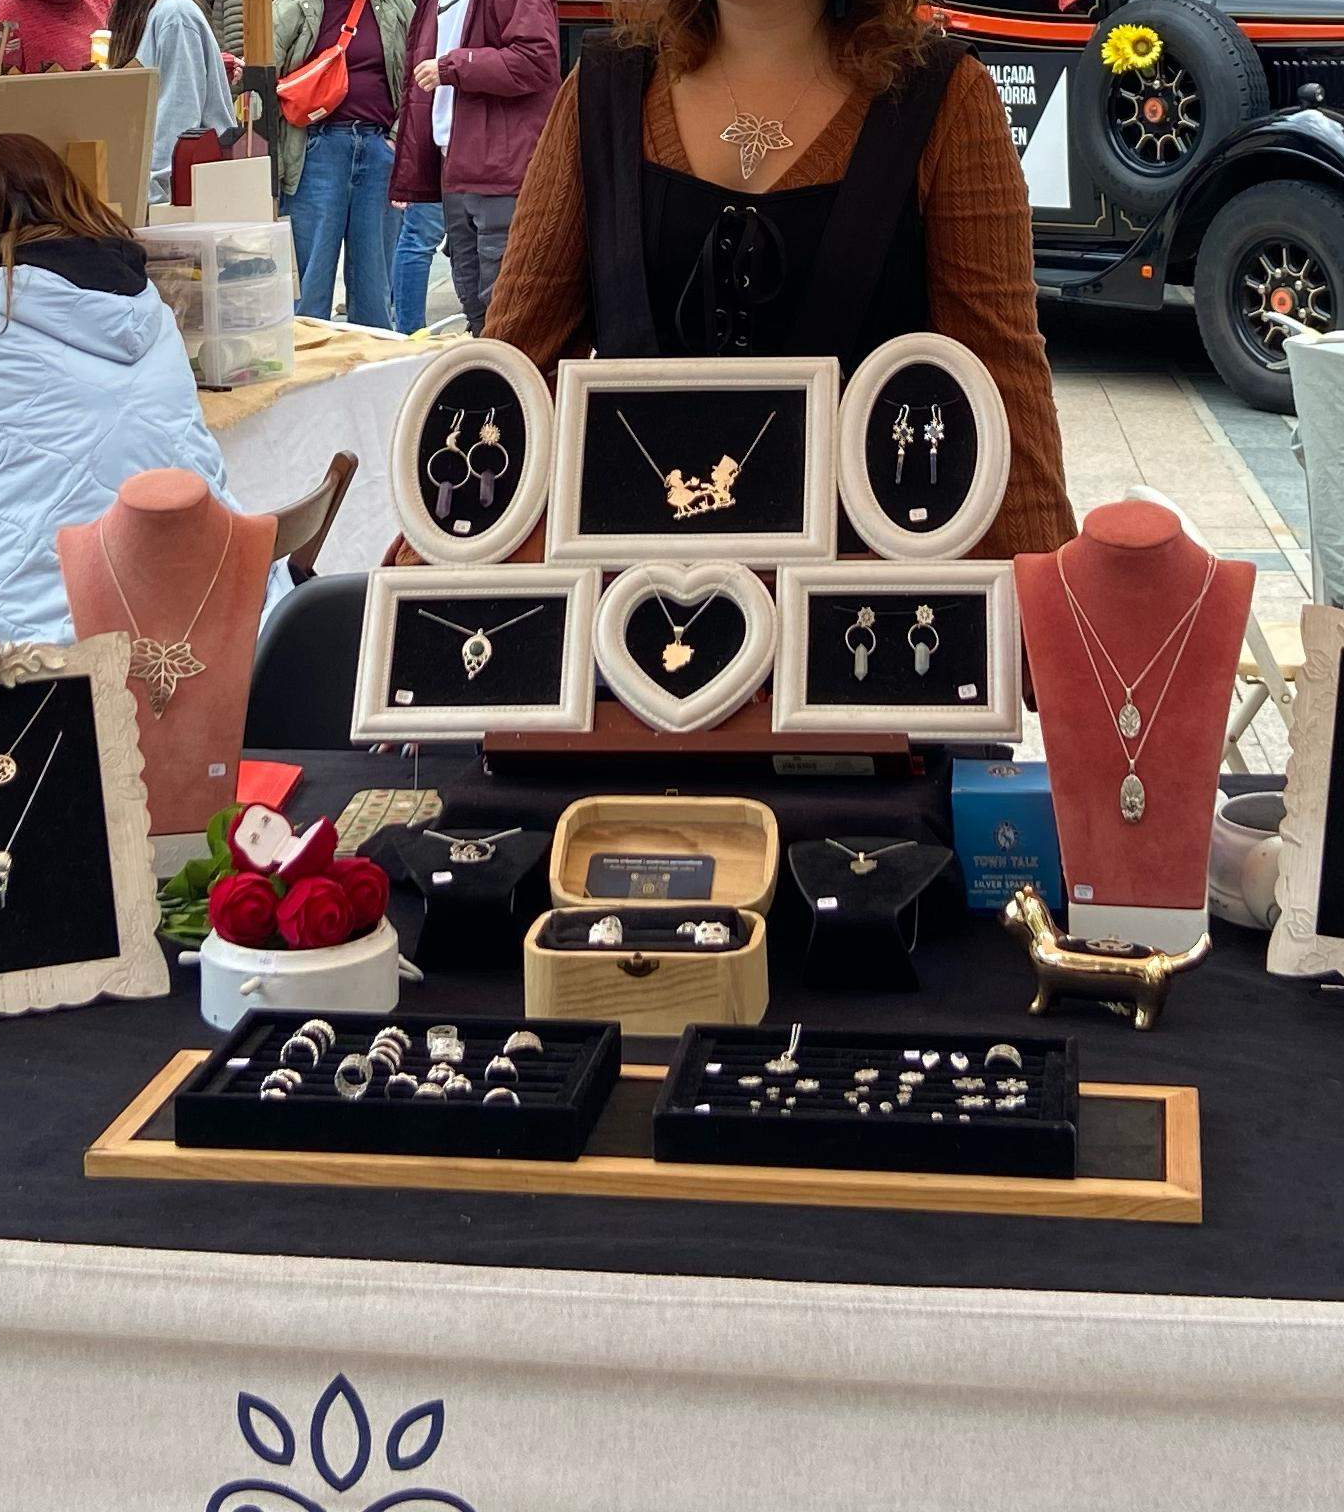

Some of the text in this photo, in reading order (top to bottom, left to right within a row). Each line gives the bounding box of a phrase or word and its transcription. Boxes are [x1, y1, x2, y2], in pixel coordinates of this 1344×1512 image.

[986, 64, 1036, 86] 'ALÇADA
[996, 85, 1037, 105] DORRA
[1011, 855, 1039, 868] TALK
